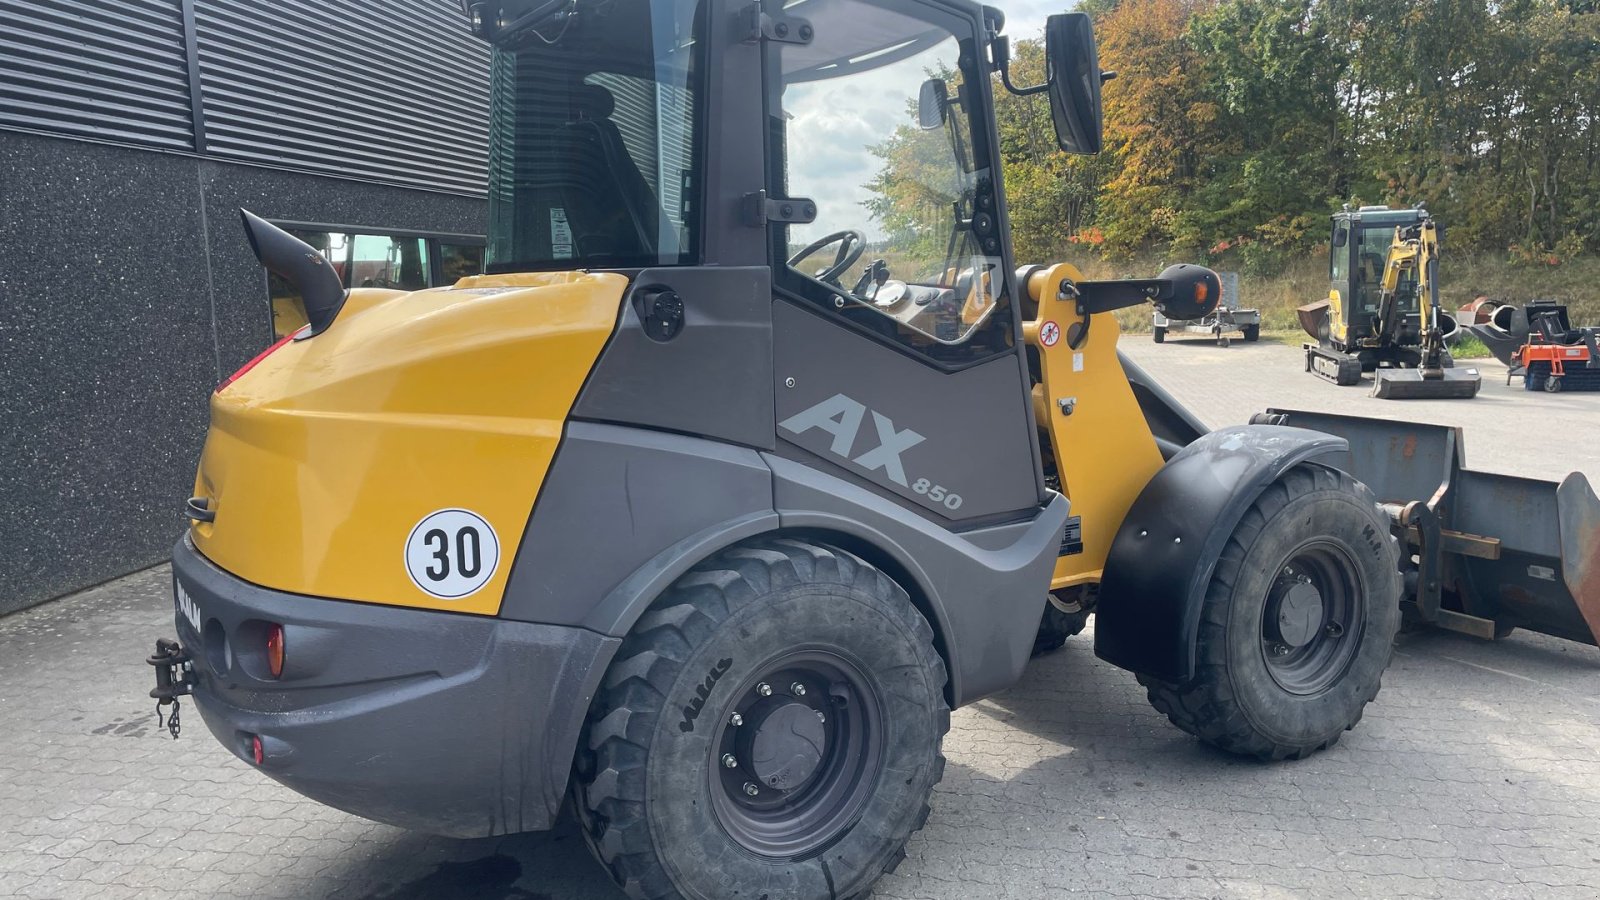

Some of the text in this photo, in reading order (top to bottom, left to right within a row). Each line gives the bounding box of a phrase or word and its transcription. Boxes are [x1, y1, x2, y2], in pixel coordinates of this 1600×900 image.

[778, 392, 963, 511] AX 850
[424, 525, 482, 582] 30
